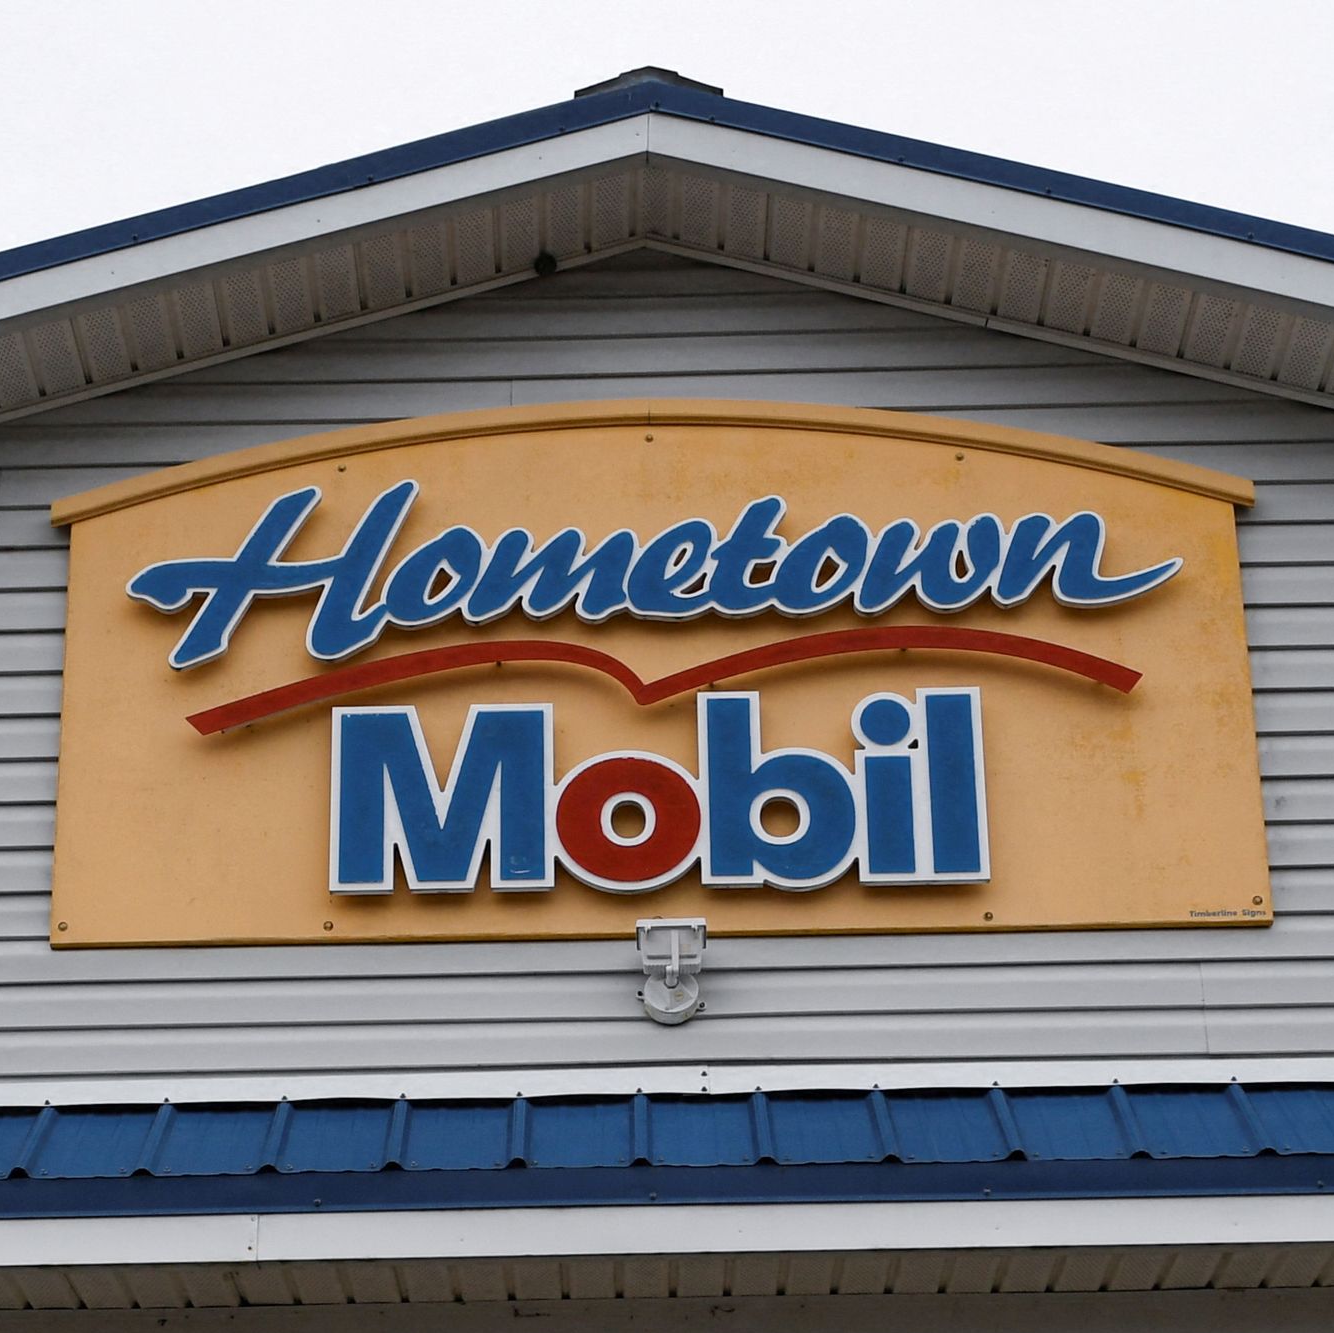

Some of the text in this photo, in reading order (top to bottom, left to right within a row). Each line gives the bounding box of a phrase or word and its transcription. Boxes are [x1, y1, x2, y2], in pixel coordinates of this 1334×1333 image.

[125, 478, 1184, 672] Hometown
[328, 687, 991, 894] Mobil
[1189, 908, 1267, 918] Timberline Signs
